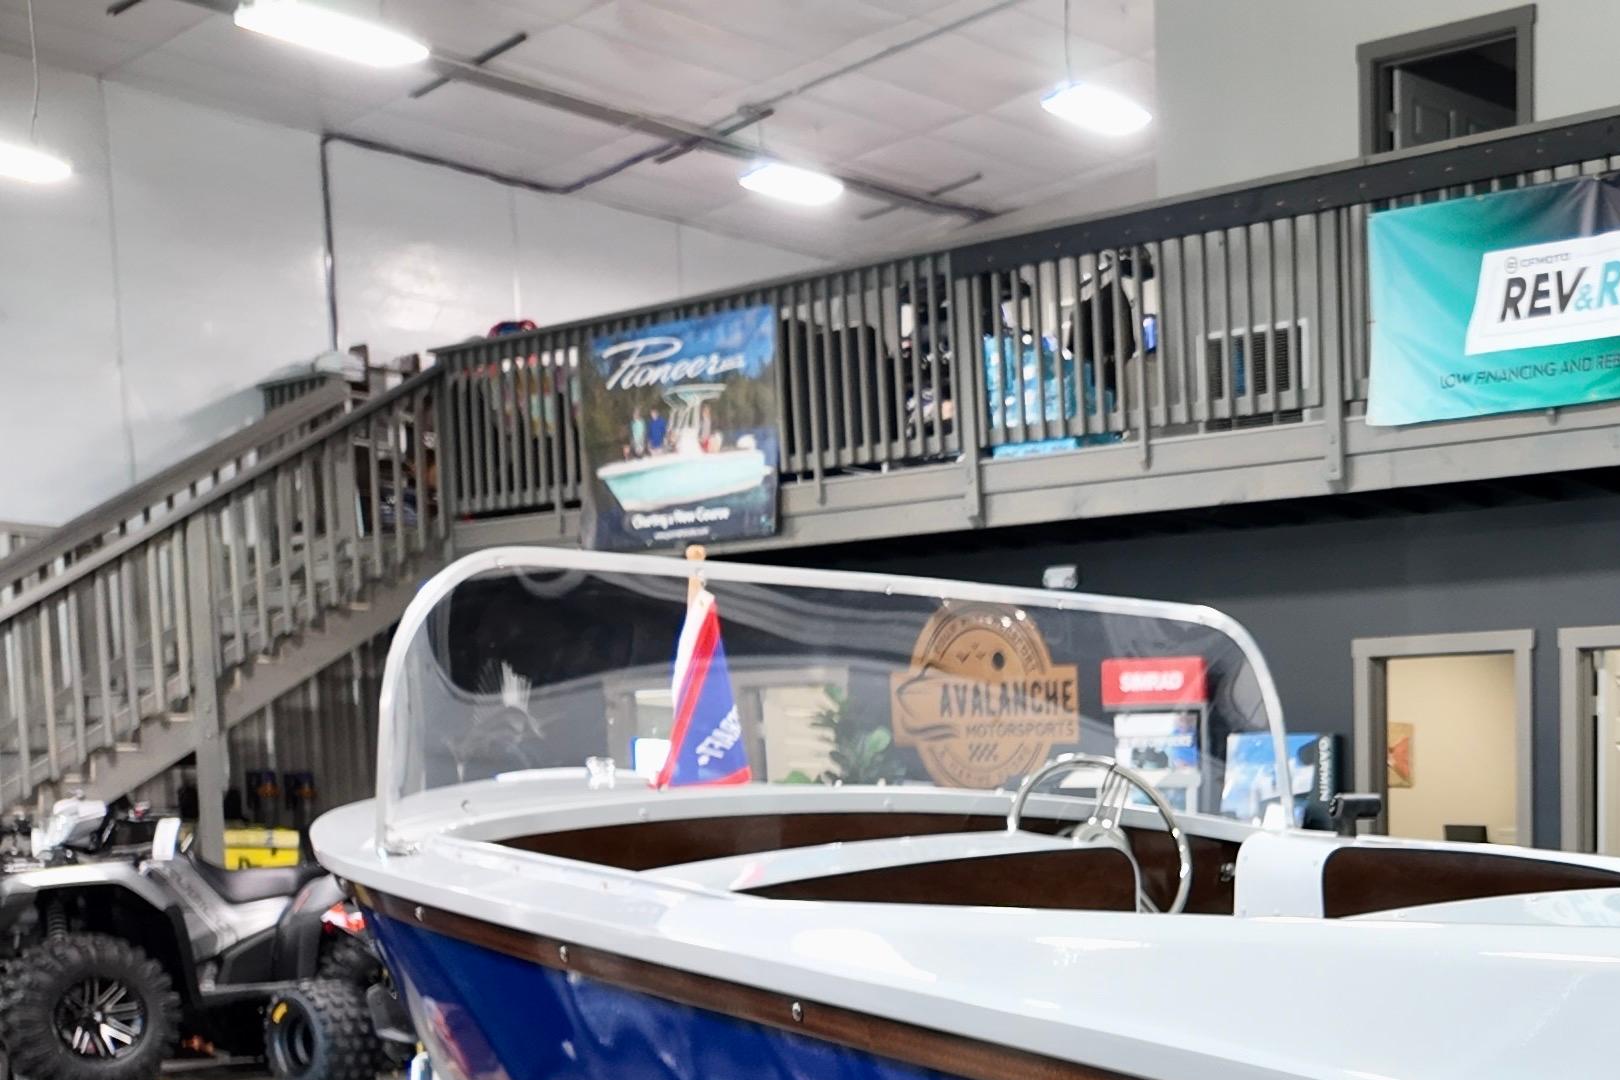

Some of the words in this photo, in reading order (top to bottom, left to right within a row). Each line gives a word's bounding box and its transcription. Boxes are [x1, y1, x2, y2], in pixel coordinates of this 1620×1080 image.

[1440, 373, 1473, 390] LOW
[1474, 362, 1556, 386] FINANCING
[1561, 357, 1593, 373] AND
[939, 679, 1076, 718] AVALANCHE
[965, 721, 1076, 739] MOTORSPORTS
[1318, 736, 1333, 801] GARMIN
